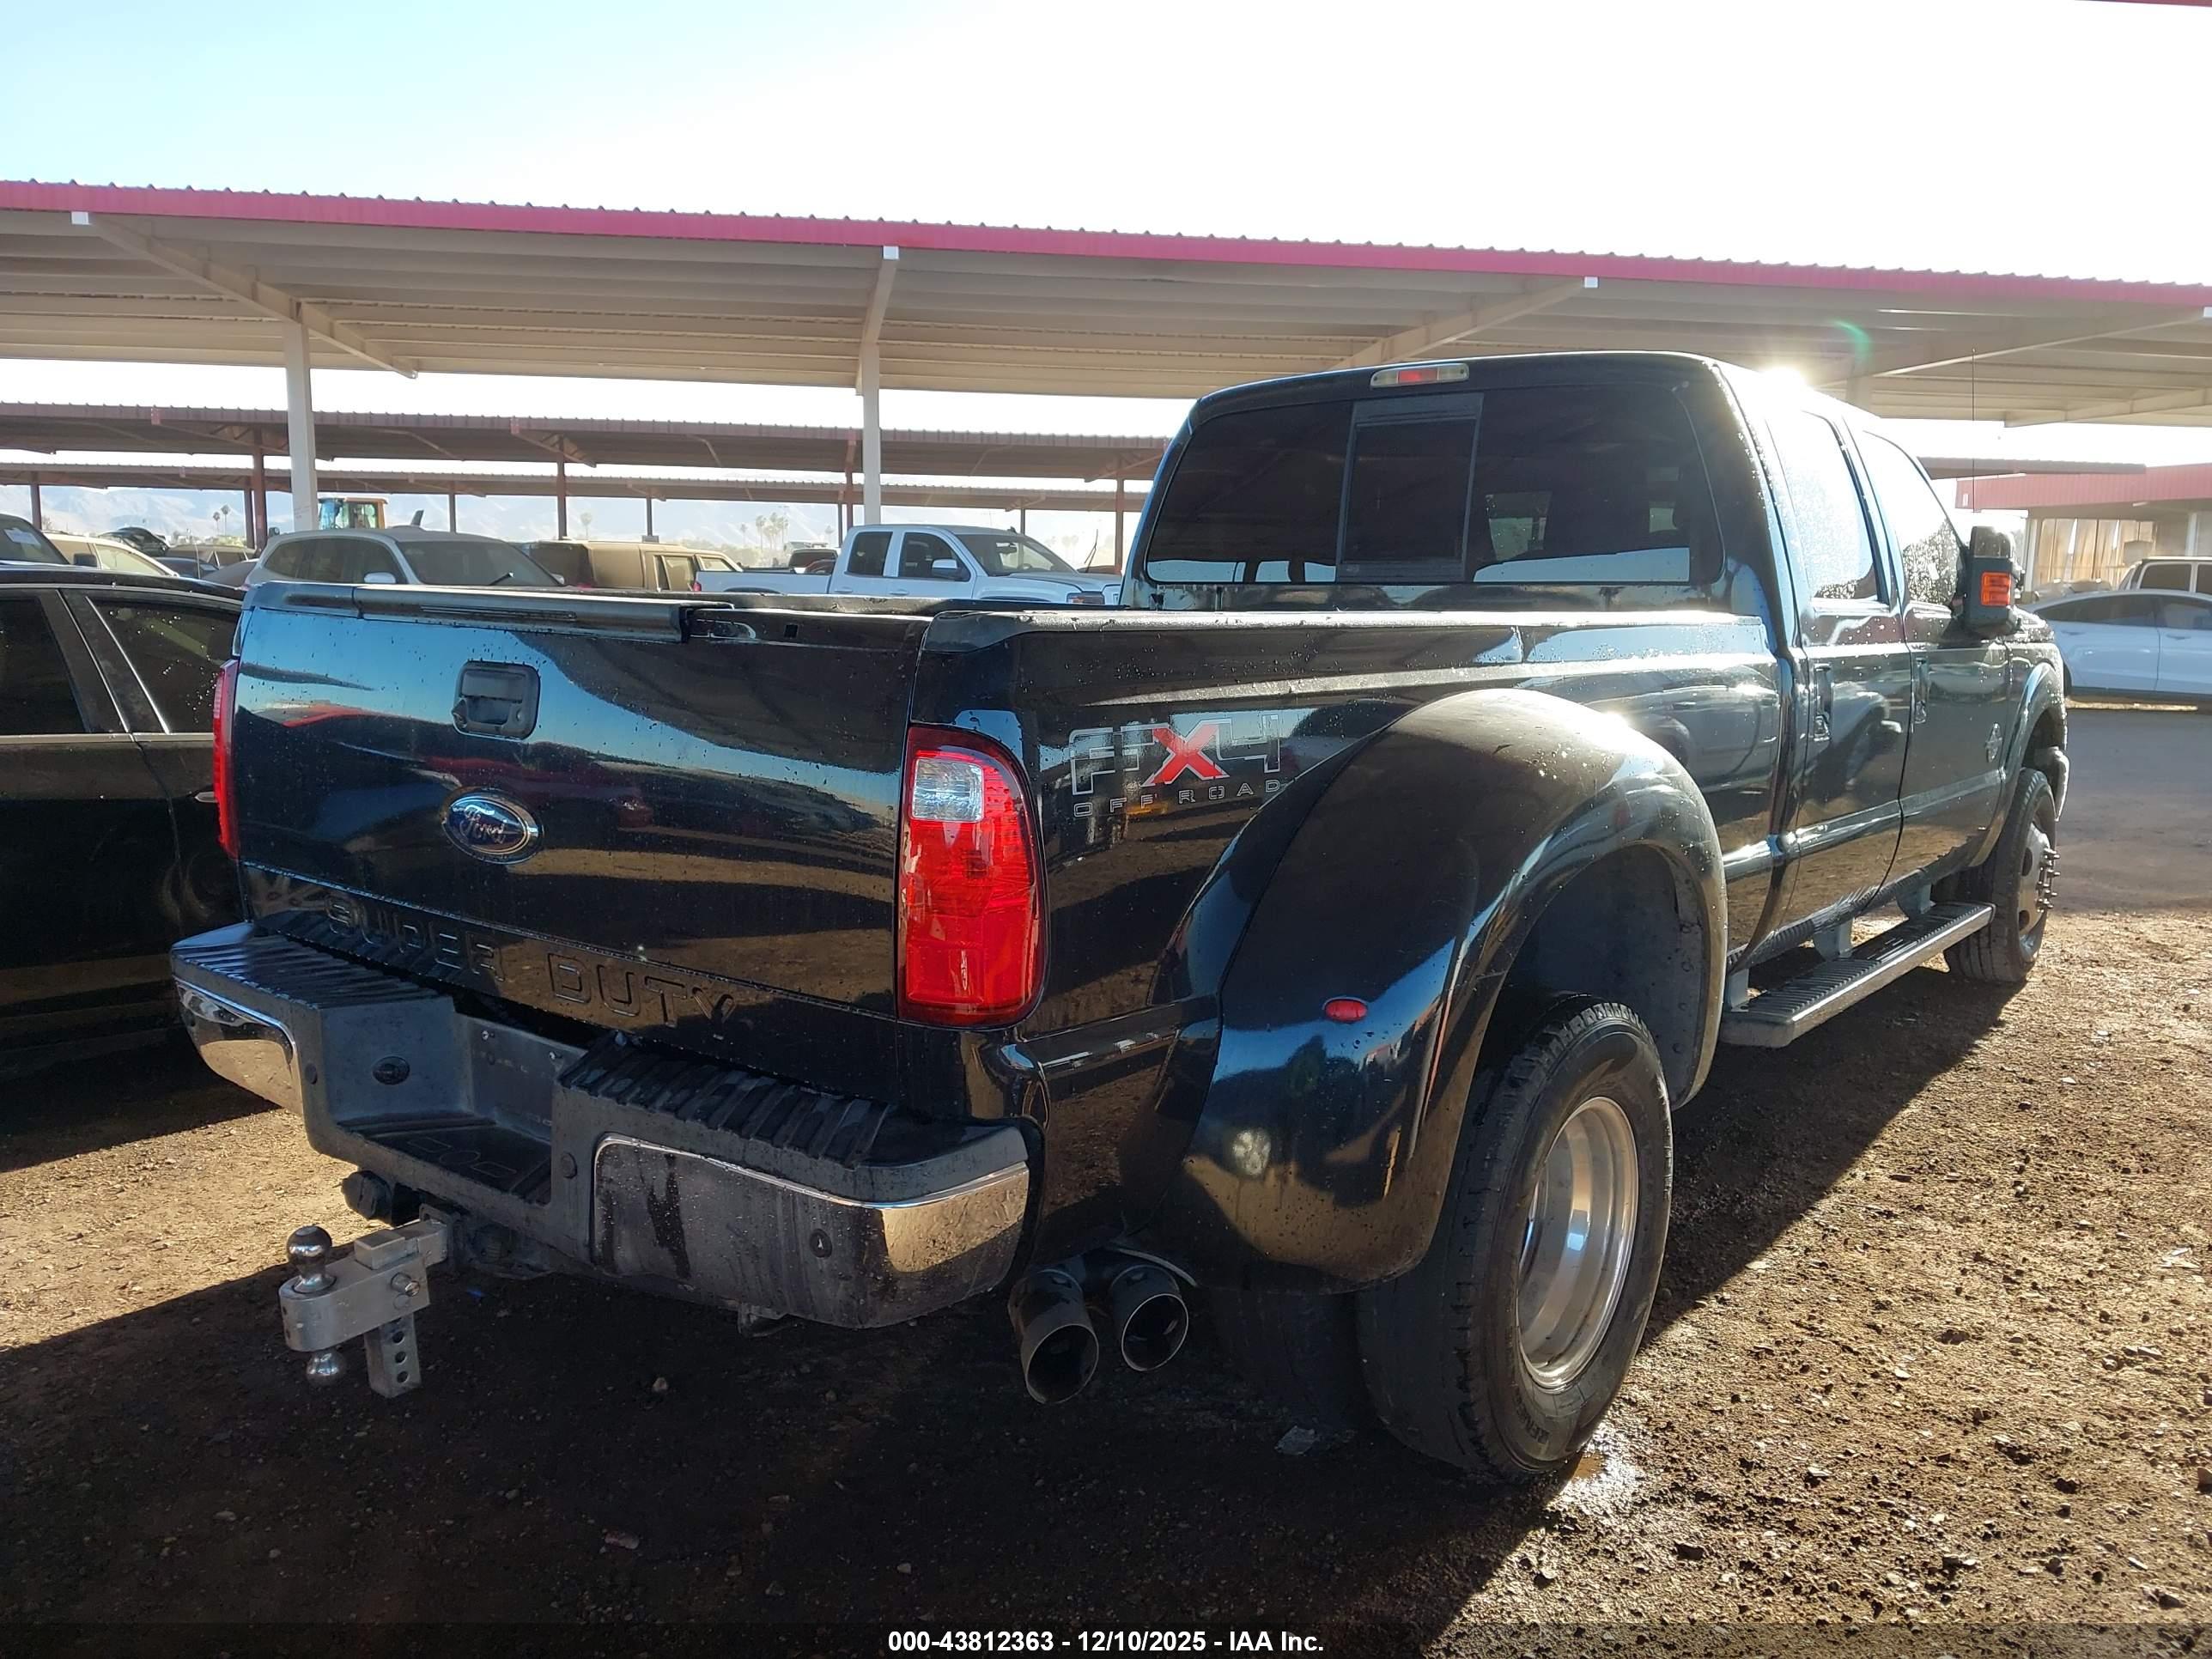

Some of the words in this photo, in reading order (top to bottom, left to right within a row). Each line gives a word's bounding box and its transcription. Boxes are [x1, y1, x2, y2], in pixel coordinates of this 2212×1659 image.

[1069, 714, 1281, 796] FX4
[1073, 793, 1155, 817] OFF
[1178, 779, 1282, 805] ROAD
[547, 951, 737, 1041] DUTY
